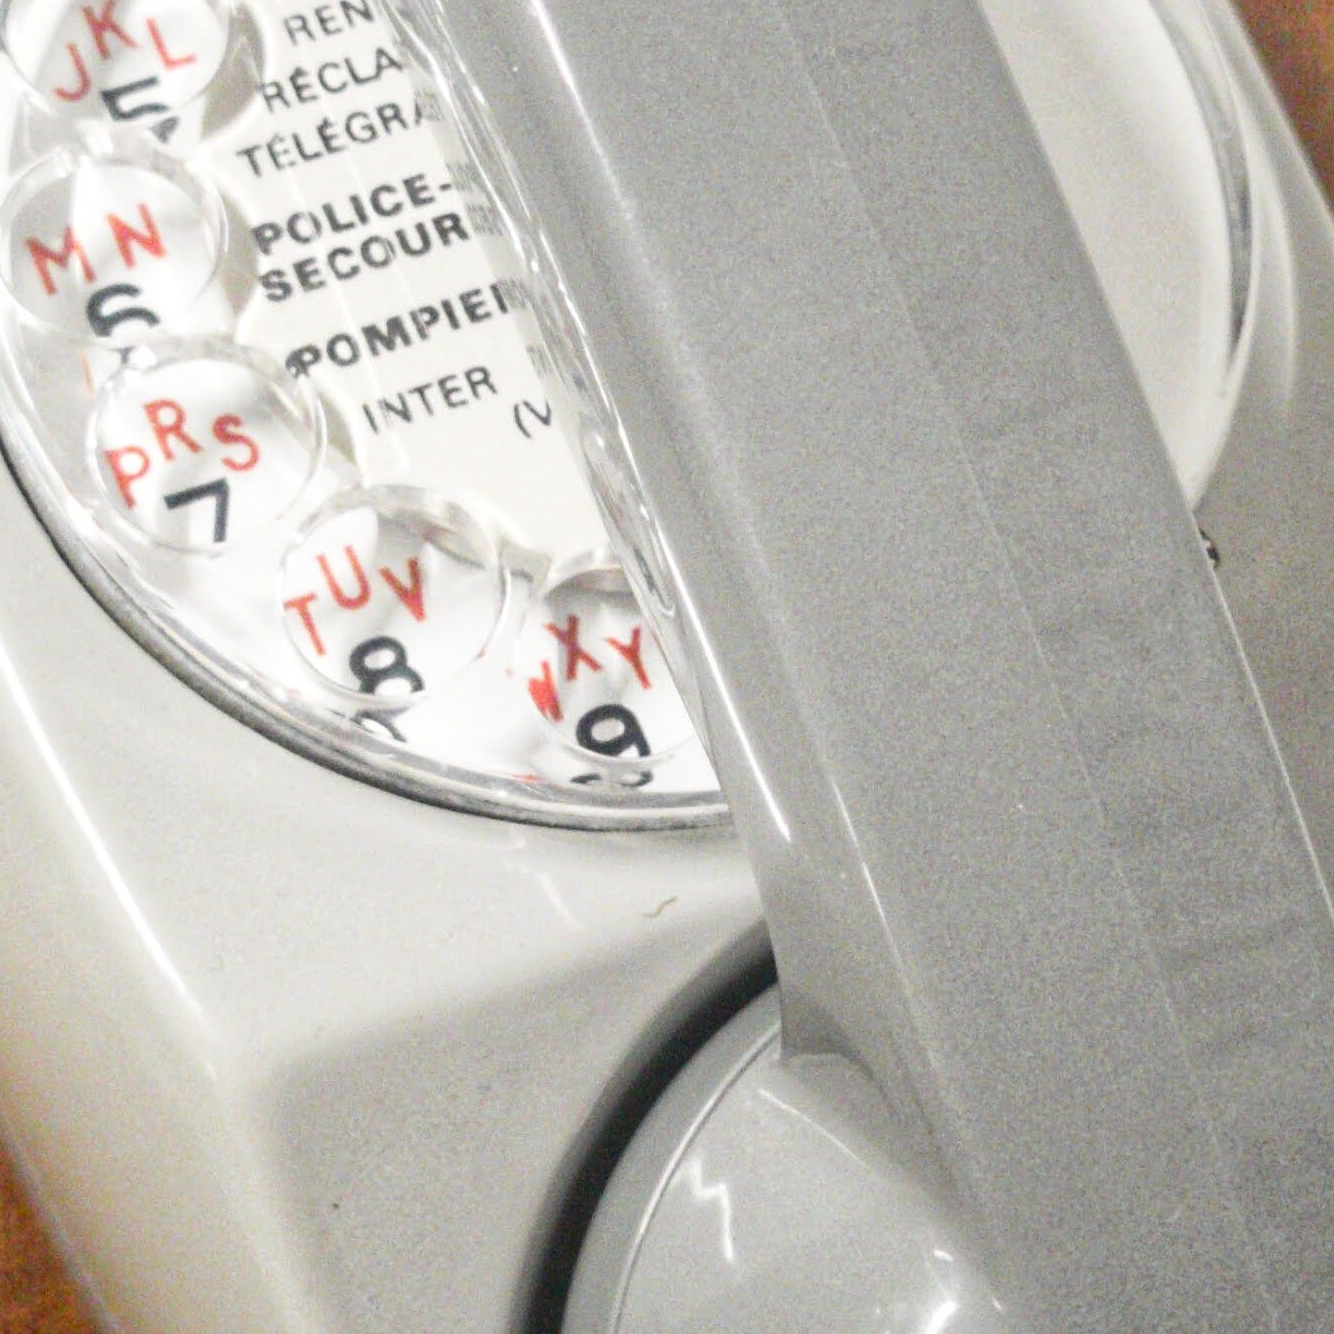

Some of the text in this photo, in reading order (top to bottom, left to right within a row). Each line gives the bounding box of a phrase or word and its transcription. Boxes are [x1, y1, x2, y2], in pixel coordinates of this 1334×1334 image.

[259, 45, 405, 114] RÉCLA
[25, 203, 166, 296] MN
[251, 172, 453, 256] POLICE-
[258, 210, 471, 304] SECOUR
[362, 365, 498, 435] INTER
[105, 398, 260, 509] PRS
[163, 478, 230, 544] 7
[283, 544, 428, 656] TUV
[348, 634, 426, 703] 8
[575, 703, 652, 761] 9
